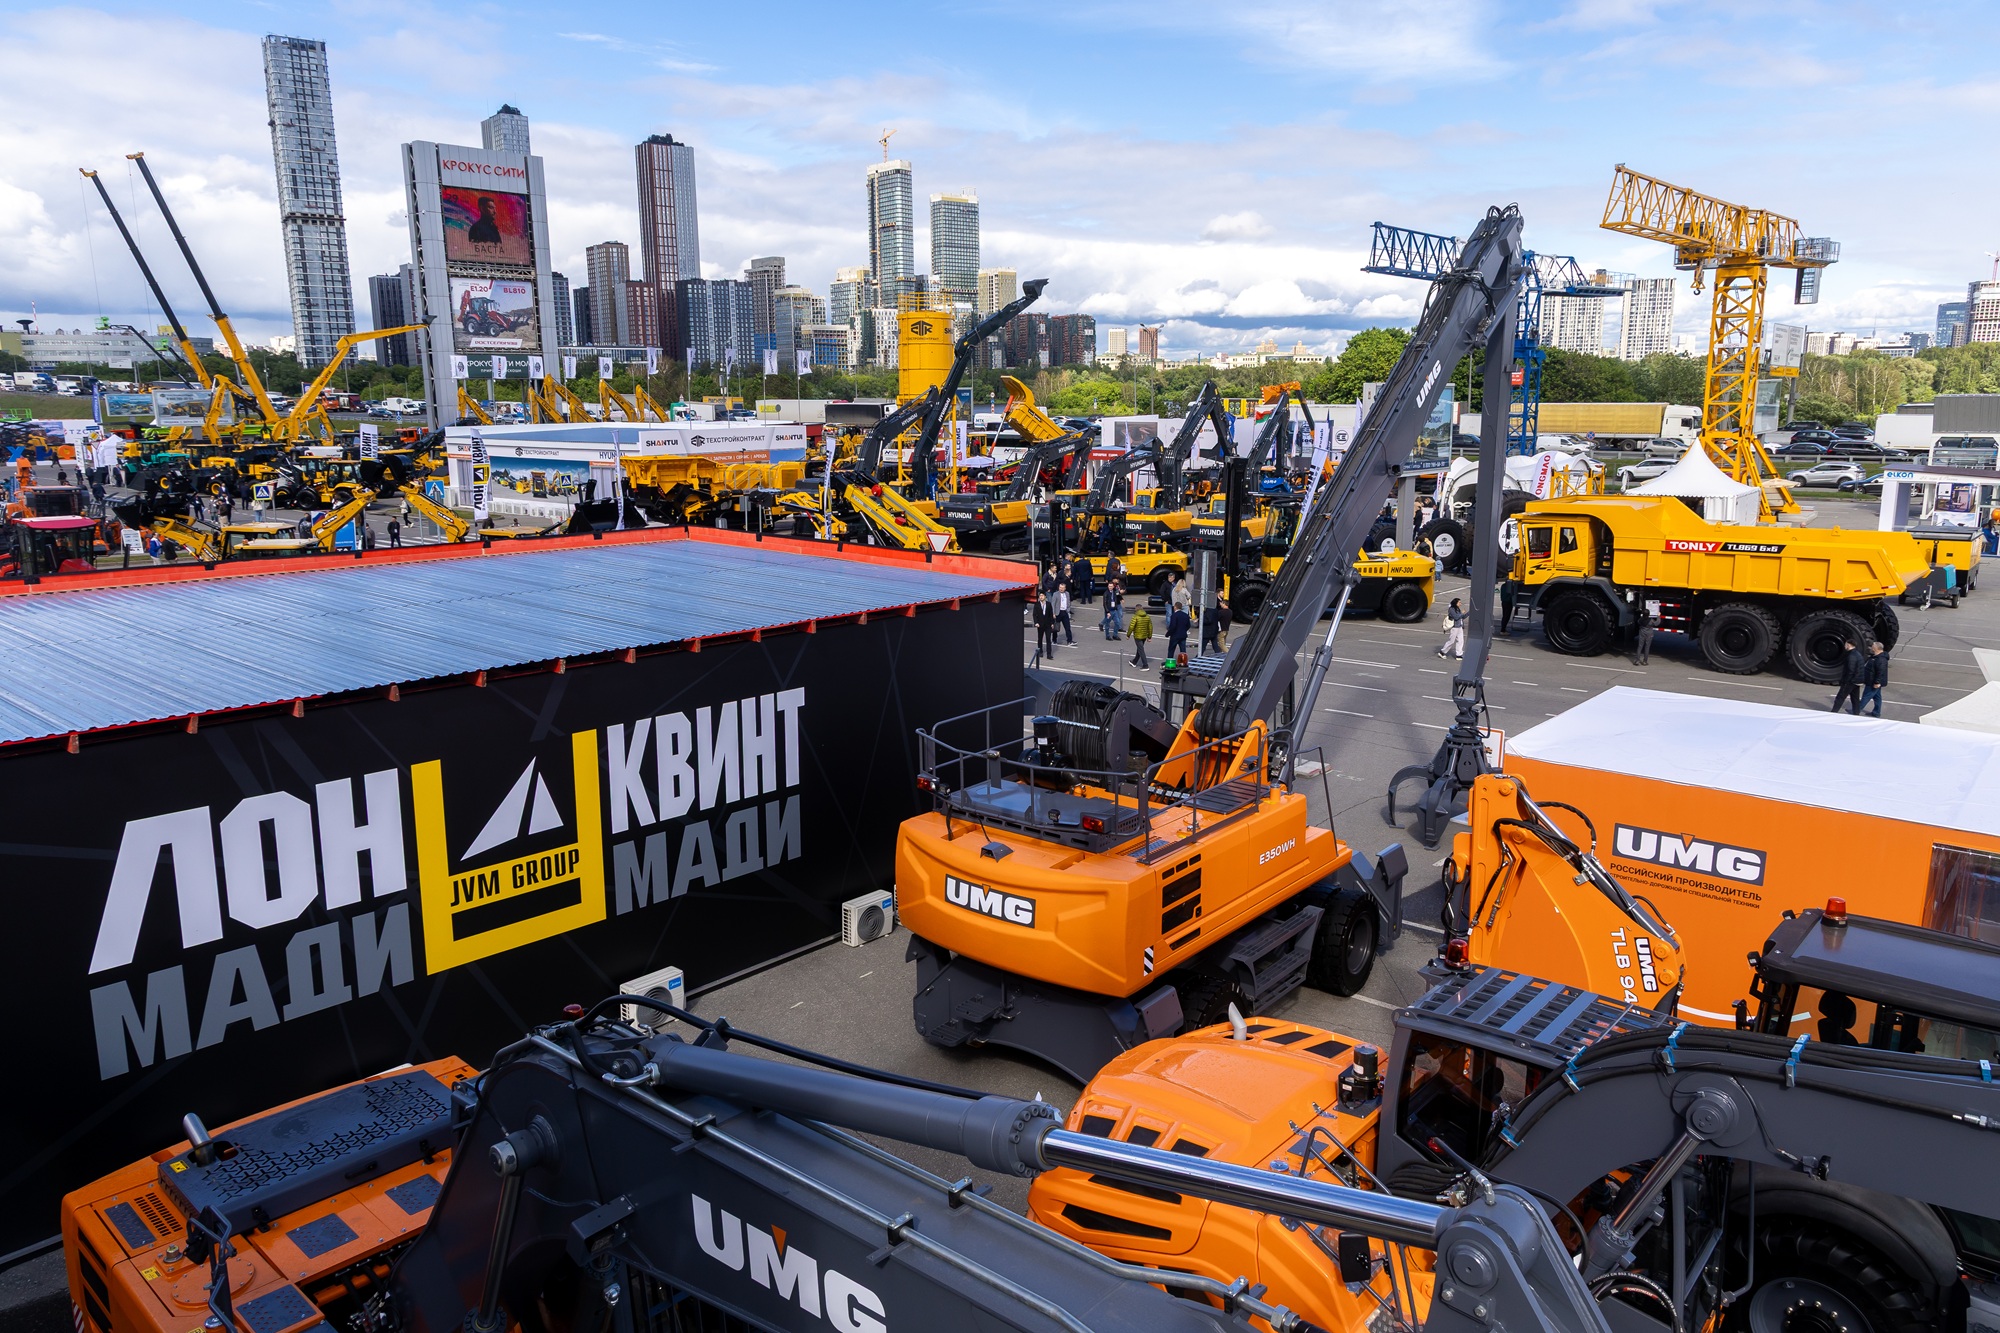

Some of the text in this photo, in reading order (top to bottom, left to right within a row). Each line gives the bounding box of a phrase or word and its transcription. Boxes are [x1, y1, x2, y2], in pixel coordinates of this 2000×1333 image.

[442, 159, 525, 179] КРОКУС СИТИ
[474, 244, 505, 254] БАСТА
[1416, 360, 1442, 408] UMG
[361, 431, 372, 458] КВИНТ
[471, 436, 484, 464] КВИНТ
[646, 439, 679, 447] SHANTUI
[706, 435, 766, 444] ТЕХСТРОЙКОНТРАКТ
[474, 485, 484, 511] ЛОН
[947, 511, 972, 519] HYUNDAI
[1669, 541, 1716, 551] TONLY
[606, 686, 805, 834] КВИНТ
[612, 794, 802, 916] МАДИ
[1259, 837, 1296, 865] E350WH
[1616, 827, 1762, 881] UMG
[88, 768, 407, 975] ЛОН
[450, 848, 580, 907] JVM GROUP
[1610, 862, 1762, 902] РОССИЙСКИЙ ПРОИЗВОДИТЕЛЬ
[946, 876, 1034, 926] UMG
[1688, 890, 1732, 903] СПЕЦИАЛЬНОЙ
[1732, 899, 1760, 909] ТЕХНИКИ
[1610, 926, 1632, 969] TLB
[1635, 938, 1658, 991] UMG
[89, 902, 415, 1081] МАДИ
[692, 1193, 887, 1333] UMG
